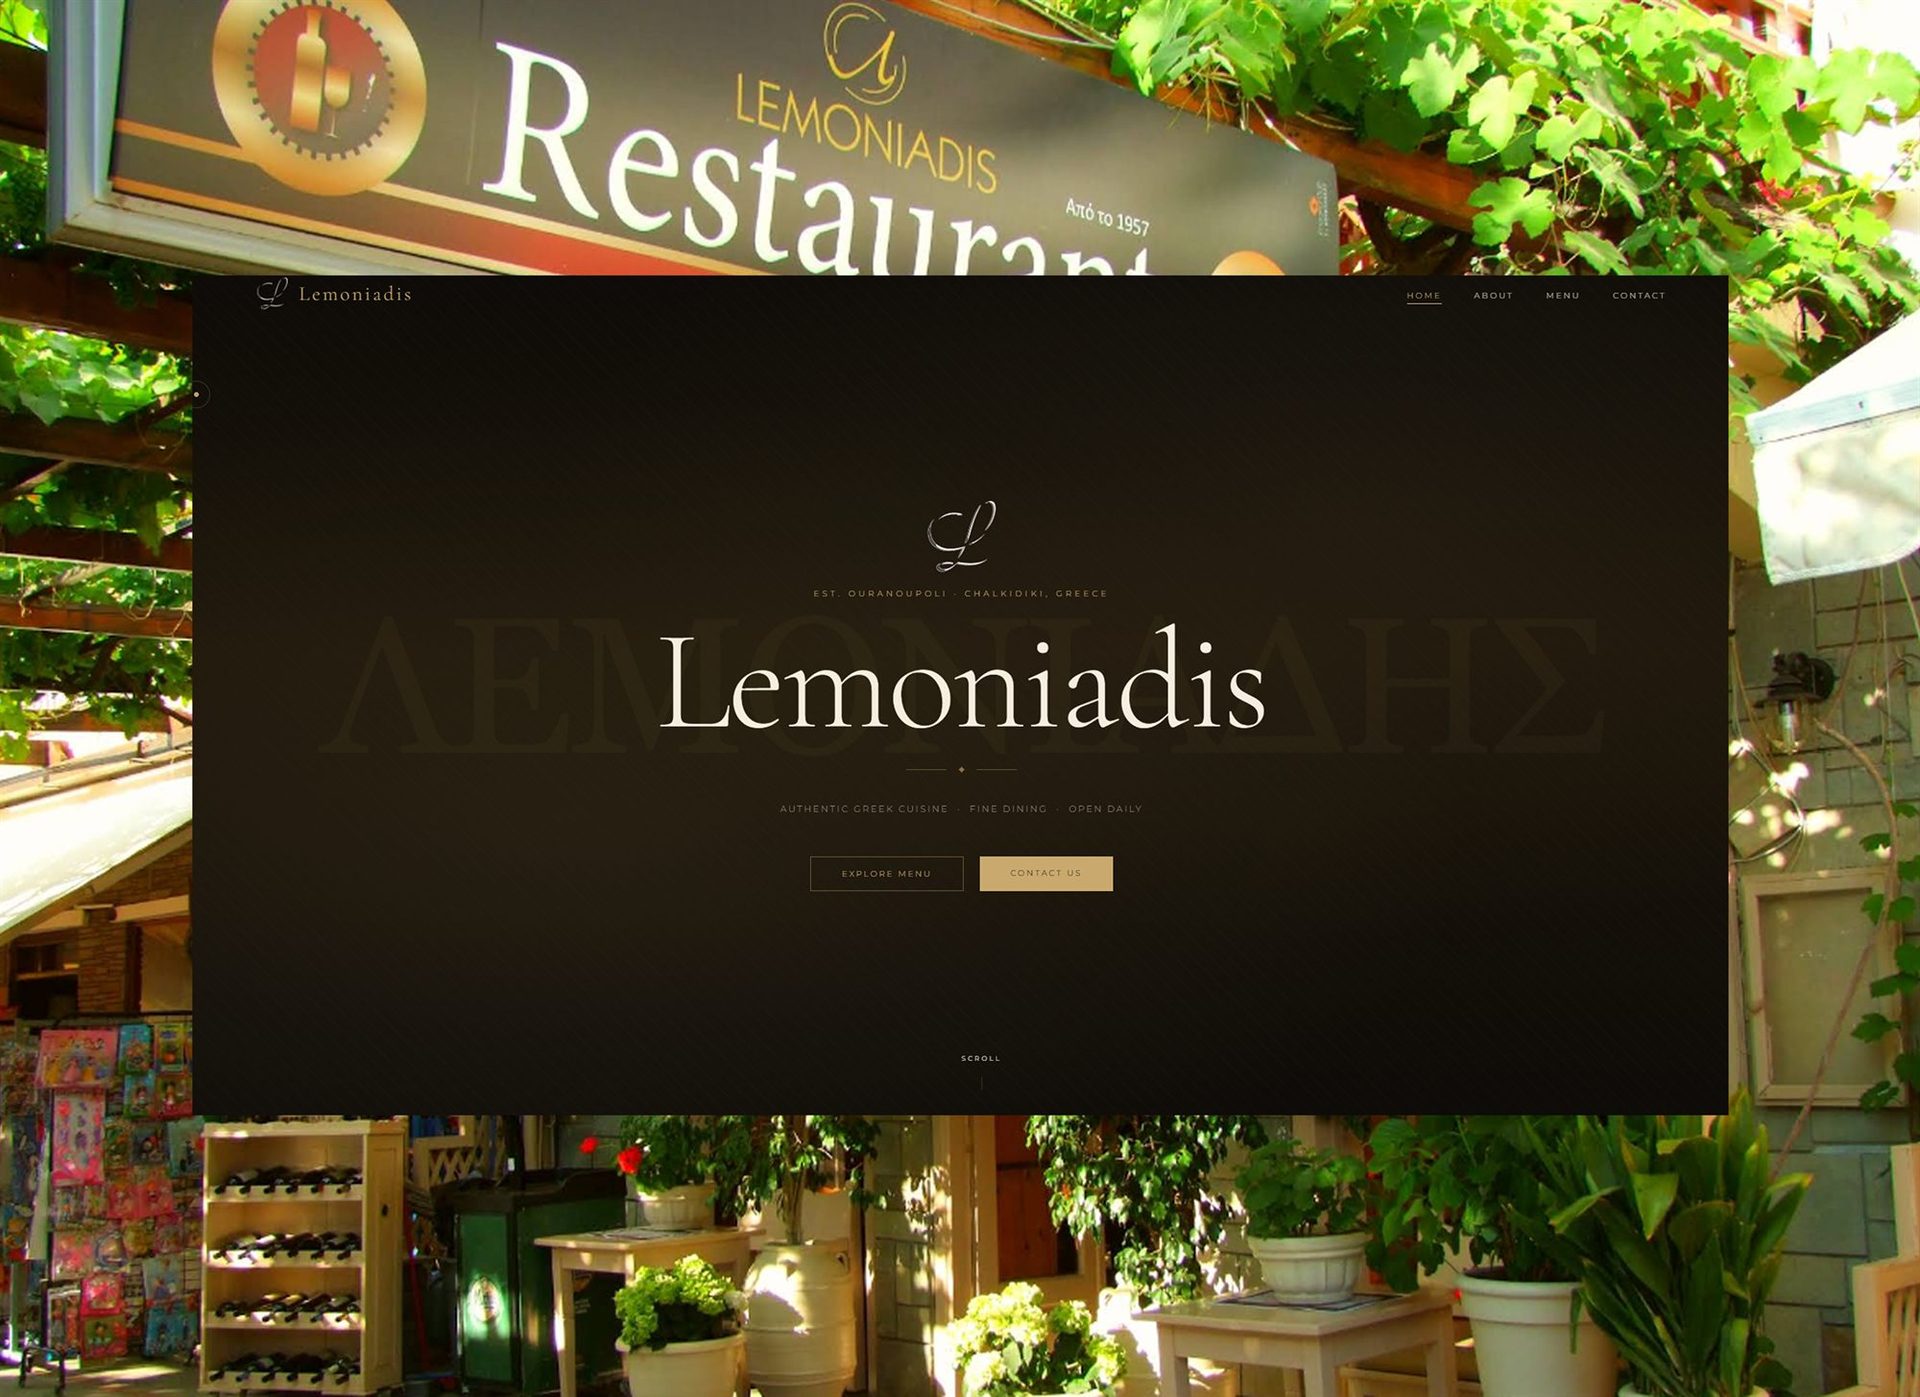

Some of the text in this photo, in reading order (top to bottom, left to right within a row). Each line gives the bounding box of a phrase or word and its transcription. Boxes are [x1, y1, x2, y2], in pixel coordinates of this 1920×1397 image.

[482, 41, 1153, 276] Restaur
[736, 73, 998, 195] LEMONIADIS
[1065, 197, 1150, 237] Από το 1957
